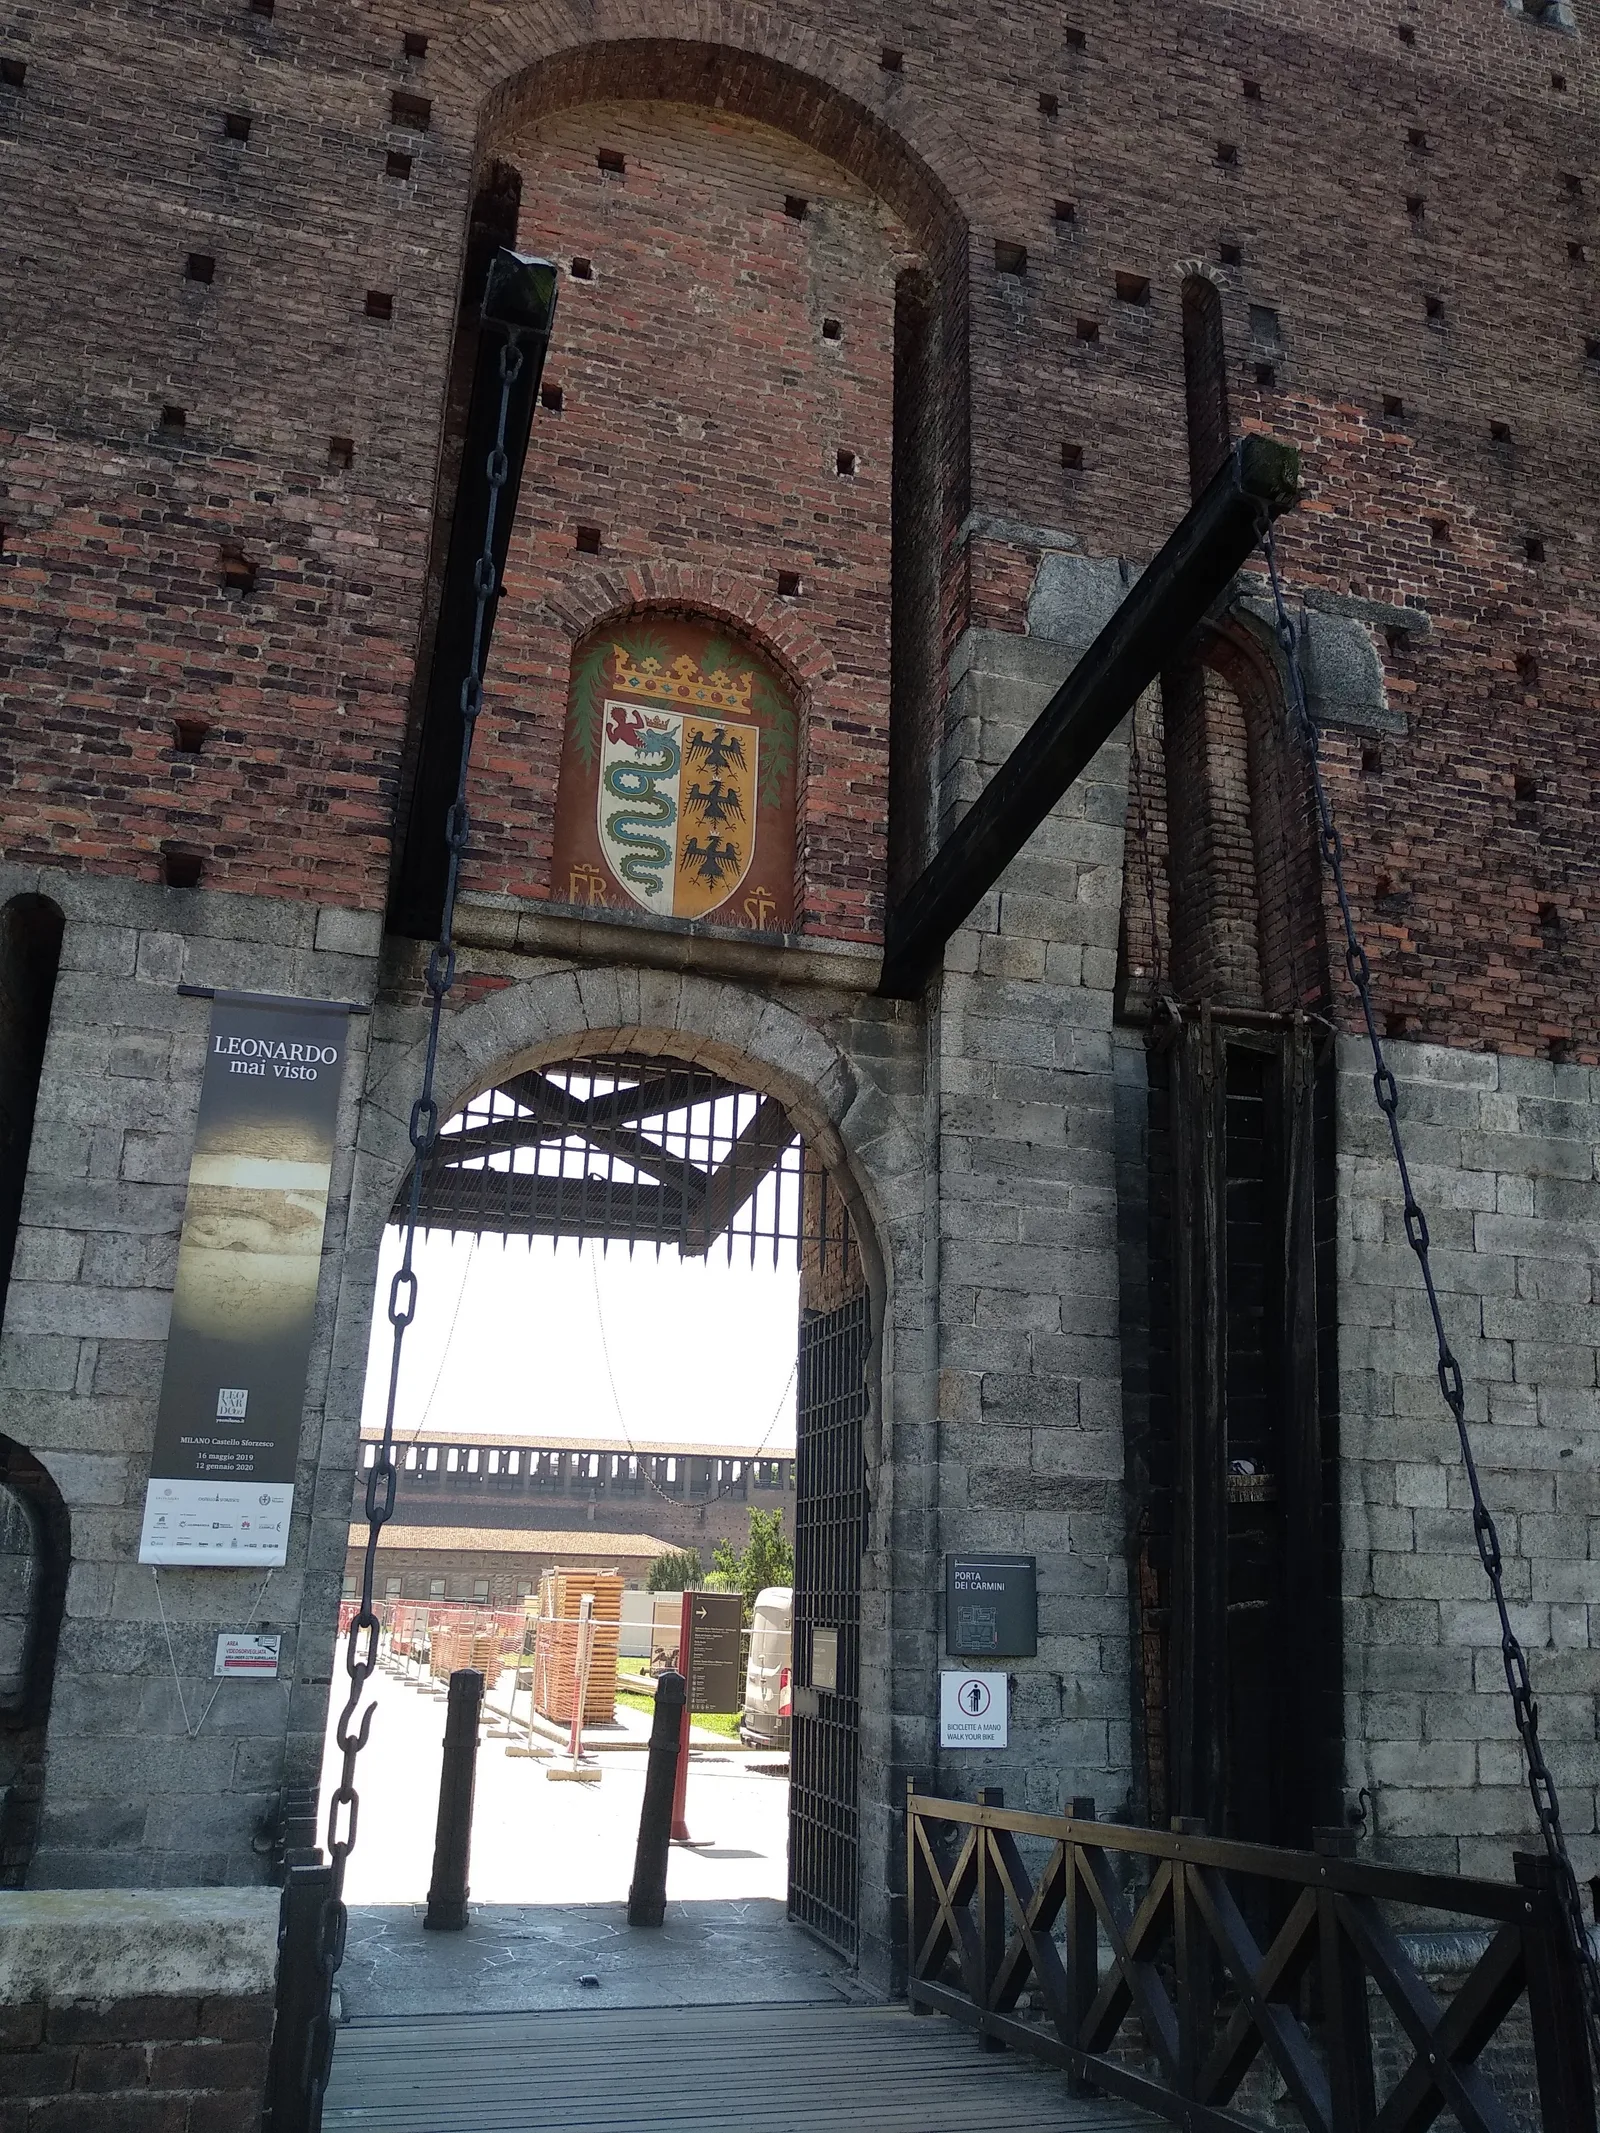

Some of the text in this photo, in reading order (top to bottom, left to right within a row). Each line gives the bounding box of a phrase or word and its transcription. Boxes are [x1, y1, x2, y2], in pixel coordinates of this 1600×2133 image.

[213, 1035, 338, 1065] LEONARDO
[229, 1059, 318, 1081] mai visto
[180, 1436, 275, 1448] MILANO Castello Sforzesco
[208, 1453, 235, 1461] maggio
[236, 1453, 254, 1461] 2019
[206, 1463, 235, 1471] gennaio
[954, 1571, 982, 1581] PORTA
[954, 1581, 1005, 1591] DEI CARMINI
[947, 1723, 977, 1731] BICICLETTE
[983, 1723, 1002, 1731] MANO
[947, 1733, 995, 1741] WALK YOUR BIKE
